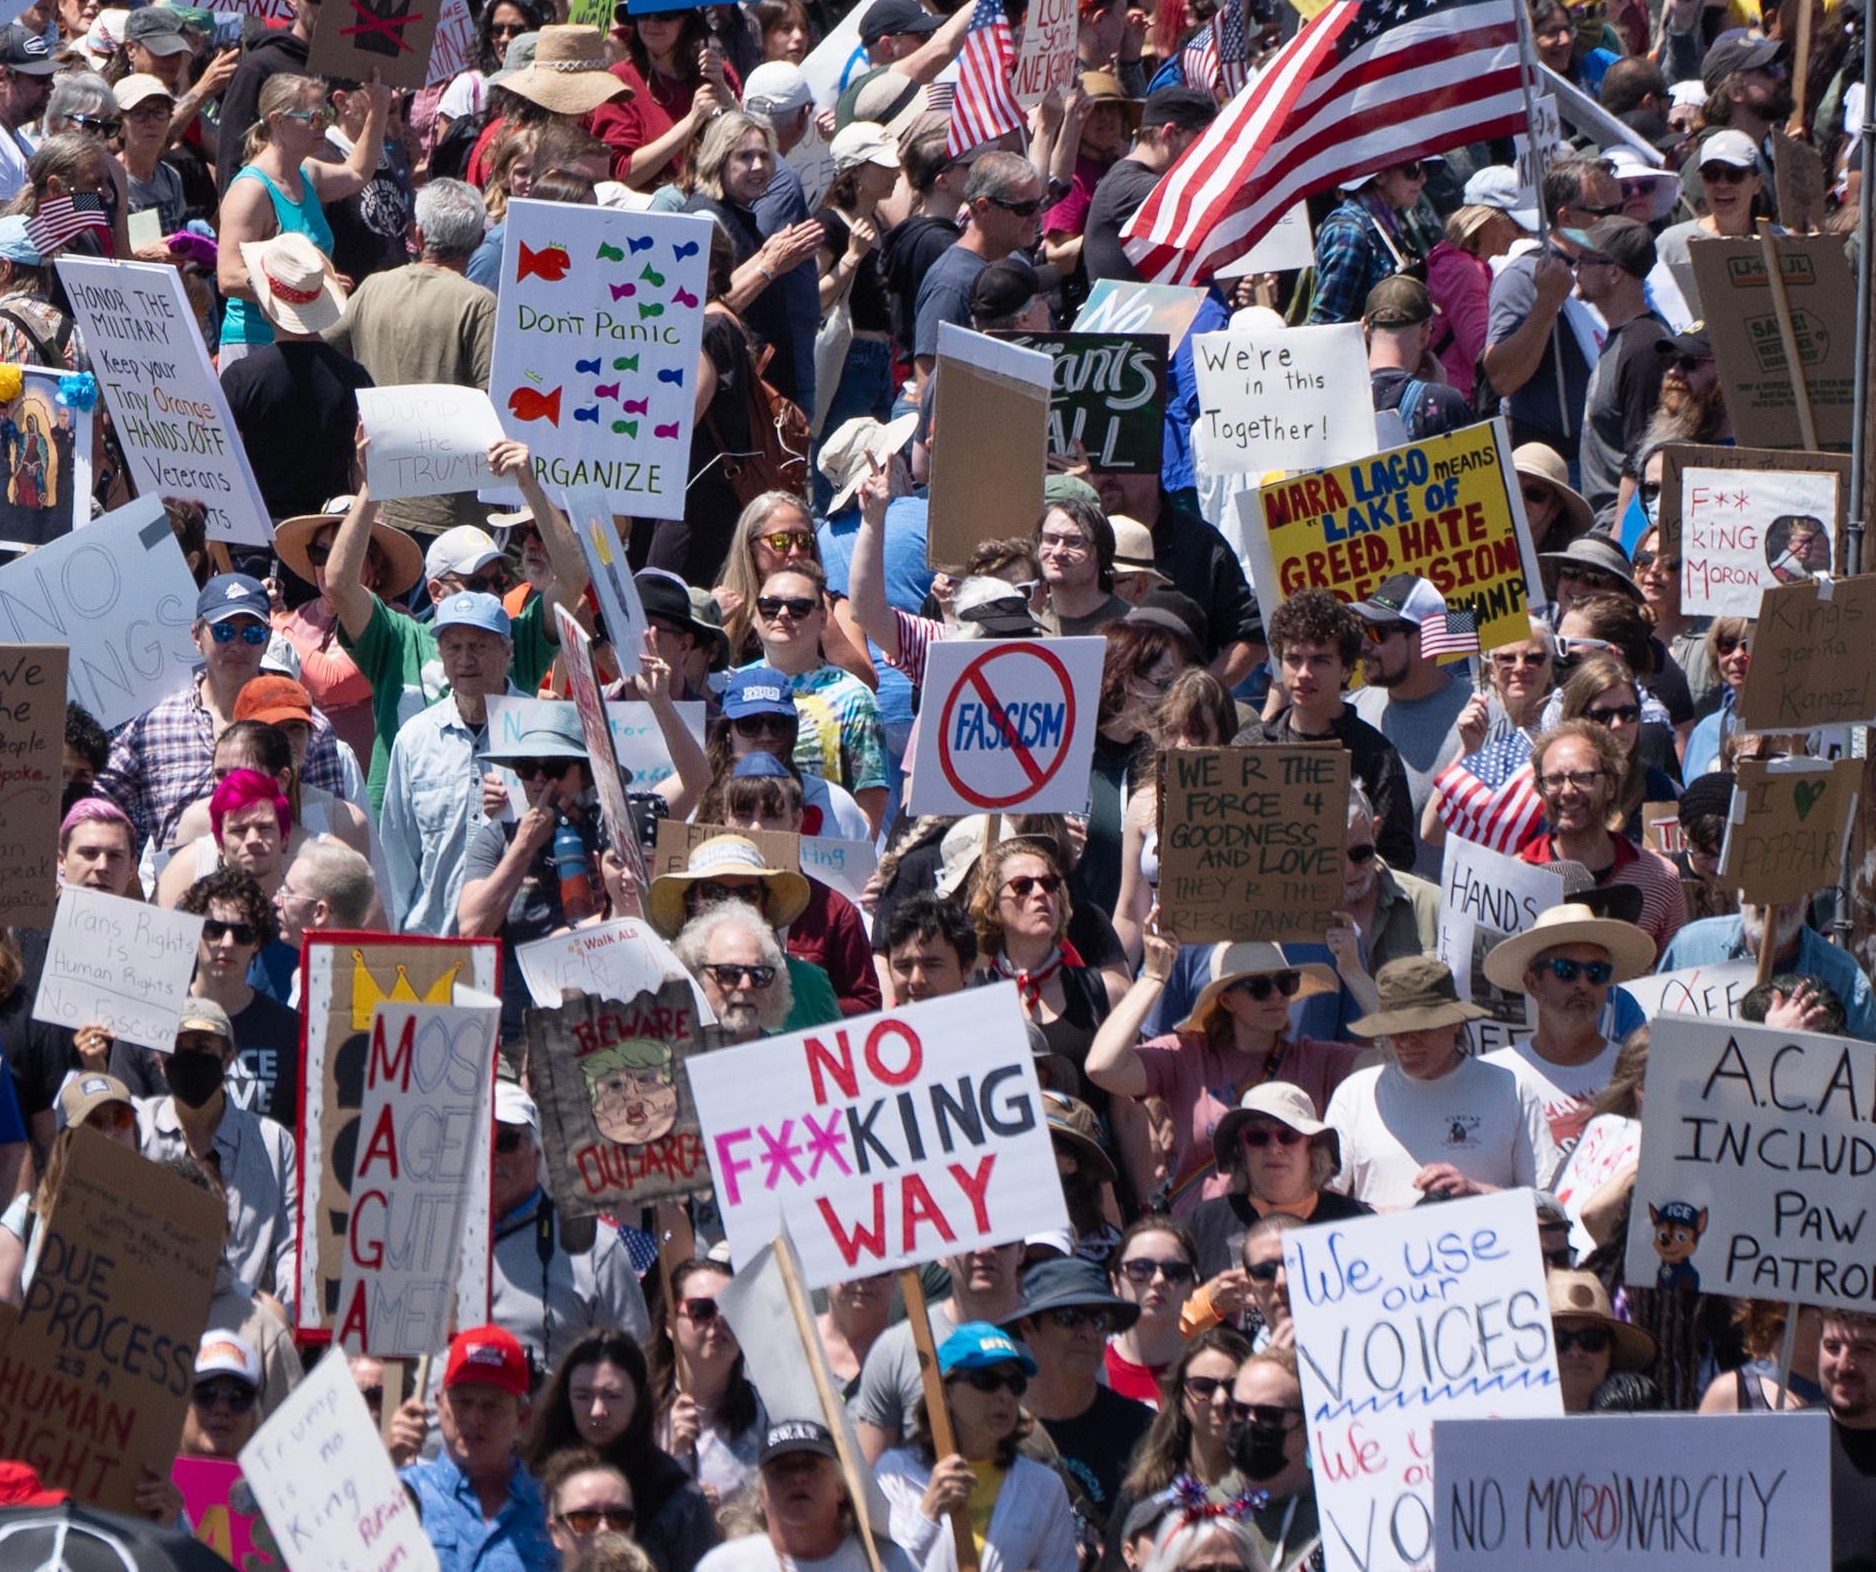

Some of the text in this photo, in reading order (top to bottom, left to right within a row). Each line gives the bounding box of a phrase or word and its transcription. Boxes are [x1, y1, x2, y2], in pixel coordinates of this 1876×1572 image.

[70, 282, 175, 318] HONOR THE
[91, 313, 168, 343] MILITARY
[595, 312, 681, 345] Panic
[101, 350, 177, 382] Keep your
[1201, 342, 1292, 372] We're
[1245, 370, 1325, 394] in this
[107, 382, 215, 428] Tiny Orange
[1265, 448, 1429, 529] MARA LAGO
[1426, 477, 1459, 513] OF
[1280, 503, 1486, 593] GREED, HATE
[954, 701, 1066, 752] FASCISM
[1177, 756, 1335, 787] WE R THE
[1185, 792, 1322, 819] FORCE 4
[1169, 823, 1318, 849] GOODNESS
[1197, 844, 1340, 875] AND LOVE
[570, 1007, 691, 1059] BEWARE
[803, 1019, 923, 1106] NO
[817, 1154, 997, 1267] WAY
[1294, 1225, 1510, 1305] We use
[1381, 1277, 1459, 1313] our
[1297, 1291, 1549, 1402] VOICES
[1451, 1479, 1507, 1552] NO
